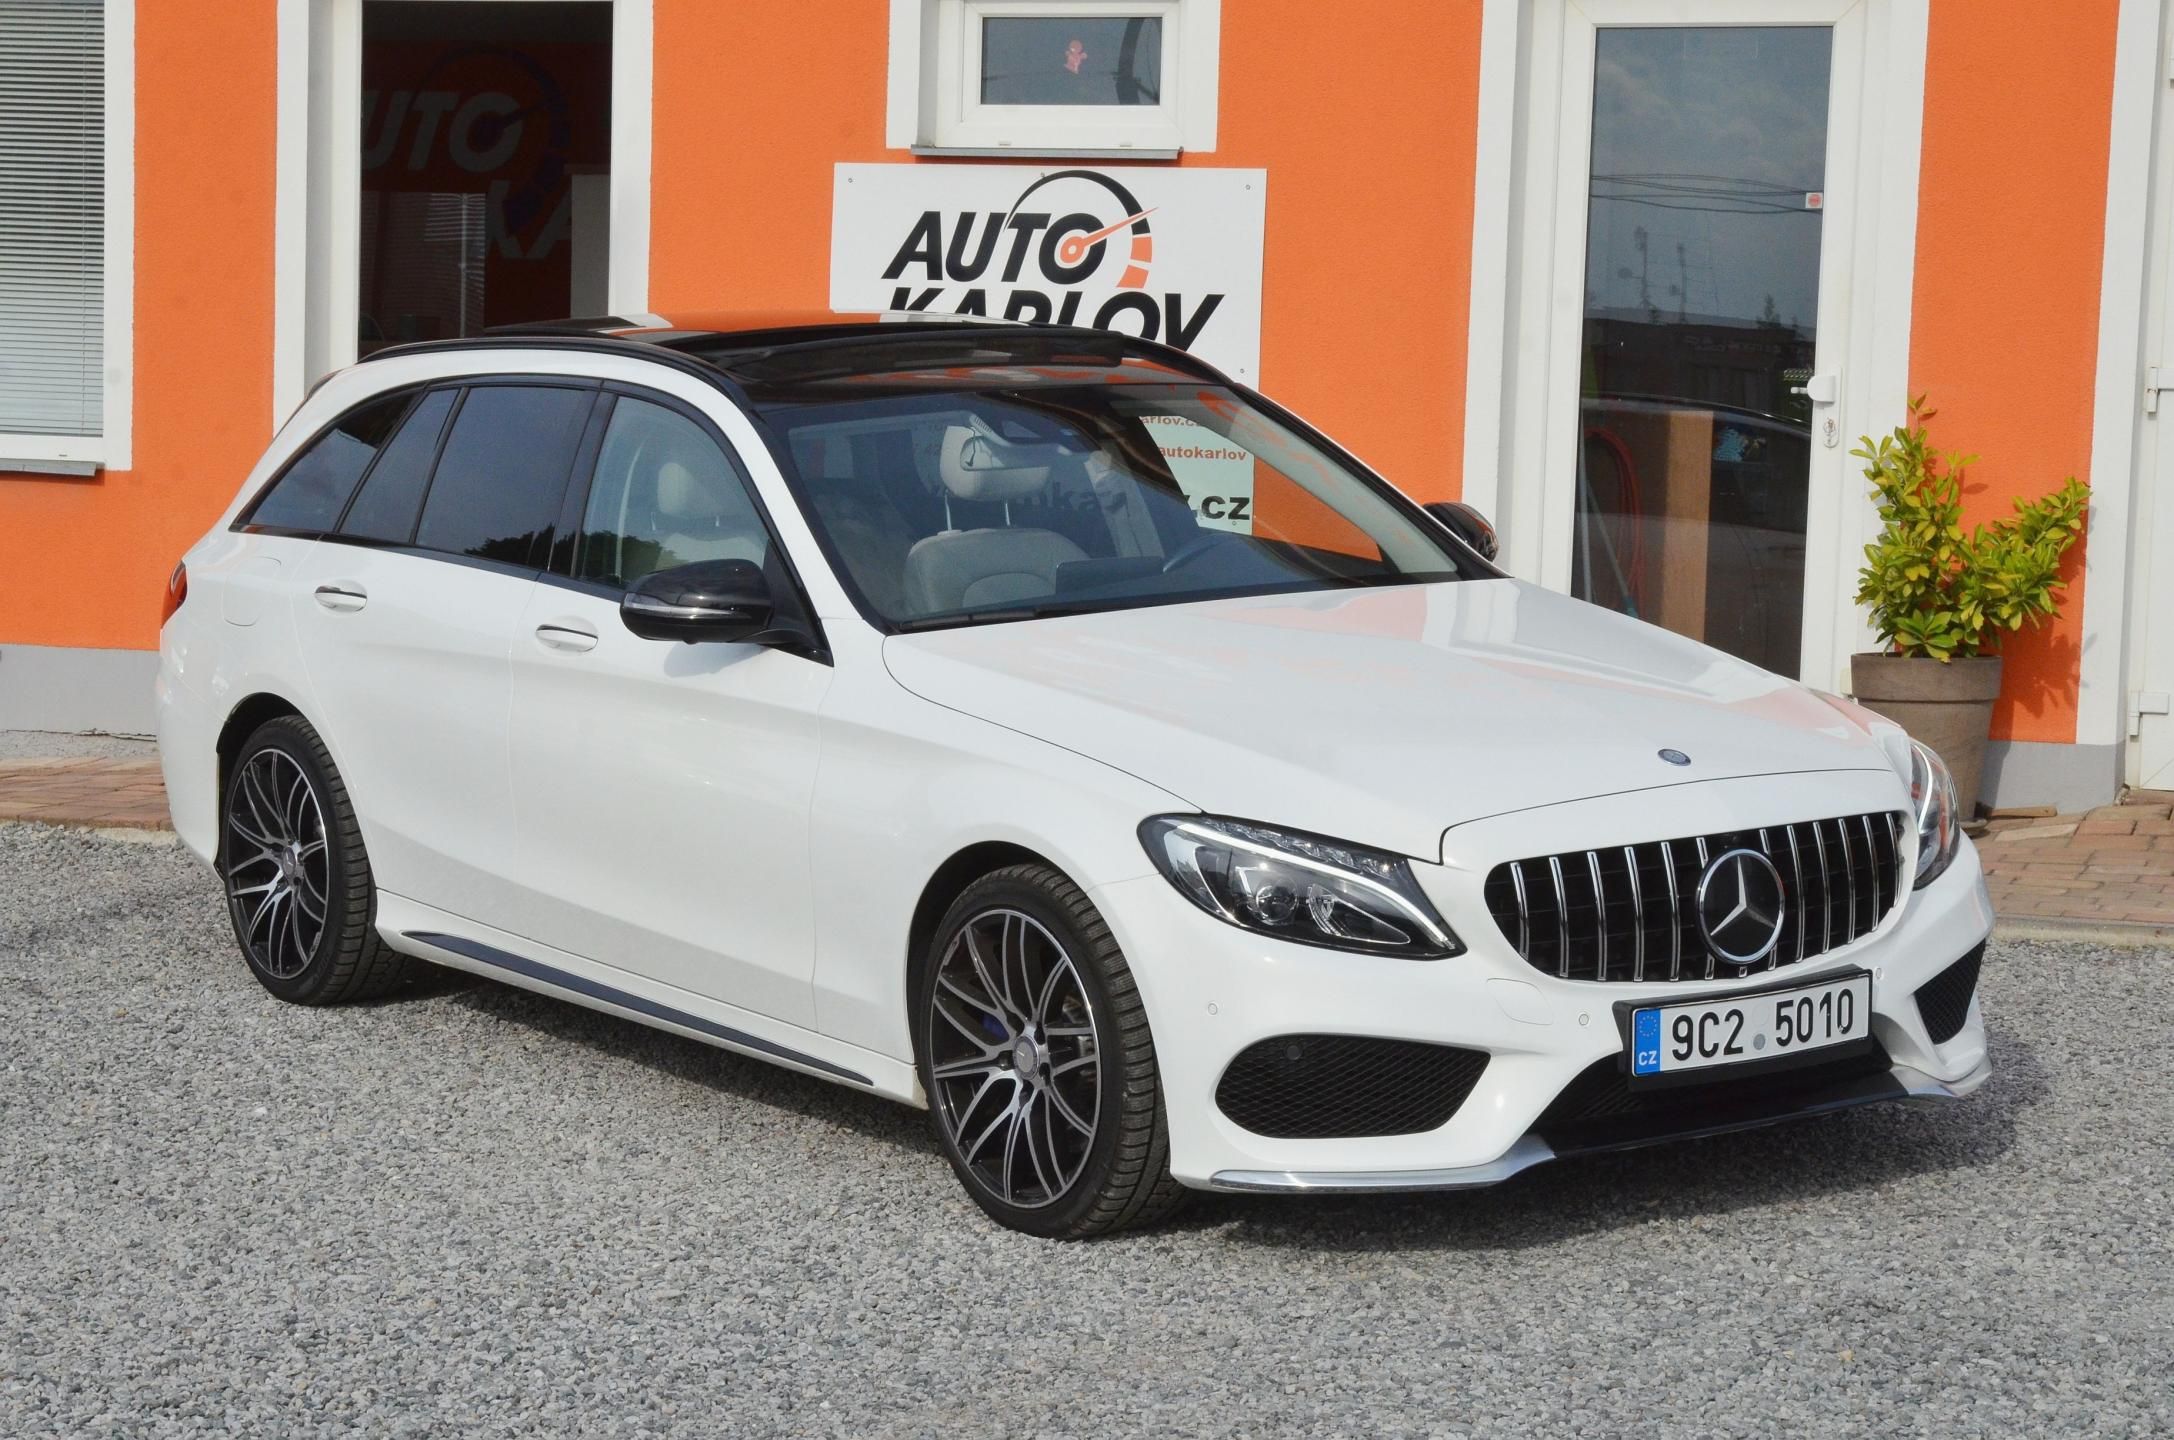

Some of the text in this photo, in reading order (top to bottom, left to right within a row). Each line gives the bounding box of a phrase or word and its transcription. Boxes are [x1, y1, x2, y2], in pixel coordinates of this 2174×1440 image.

[881, 211, 1107, 285] AUTO
[1638, 1050, 1657, 1066] CZ
[1672, 988, 1854, 1061] 9C2 5010
